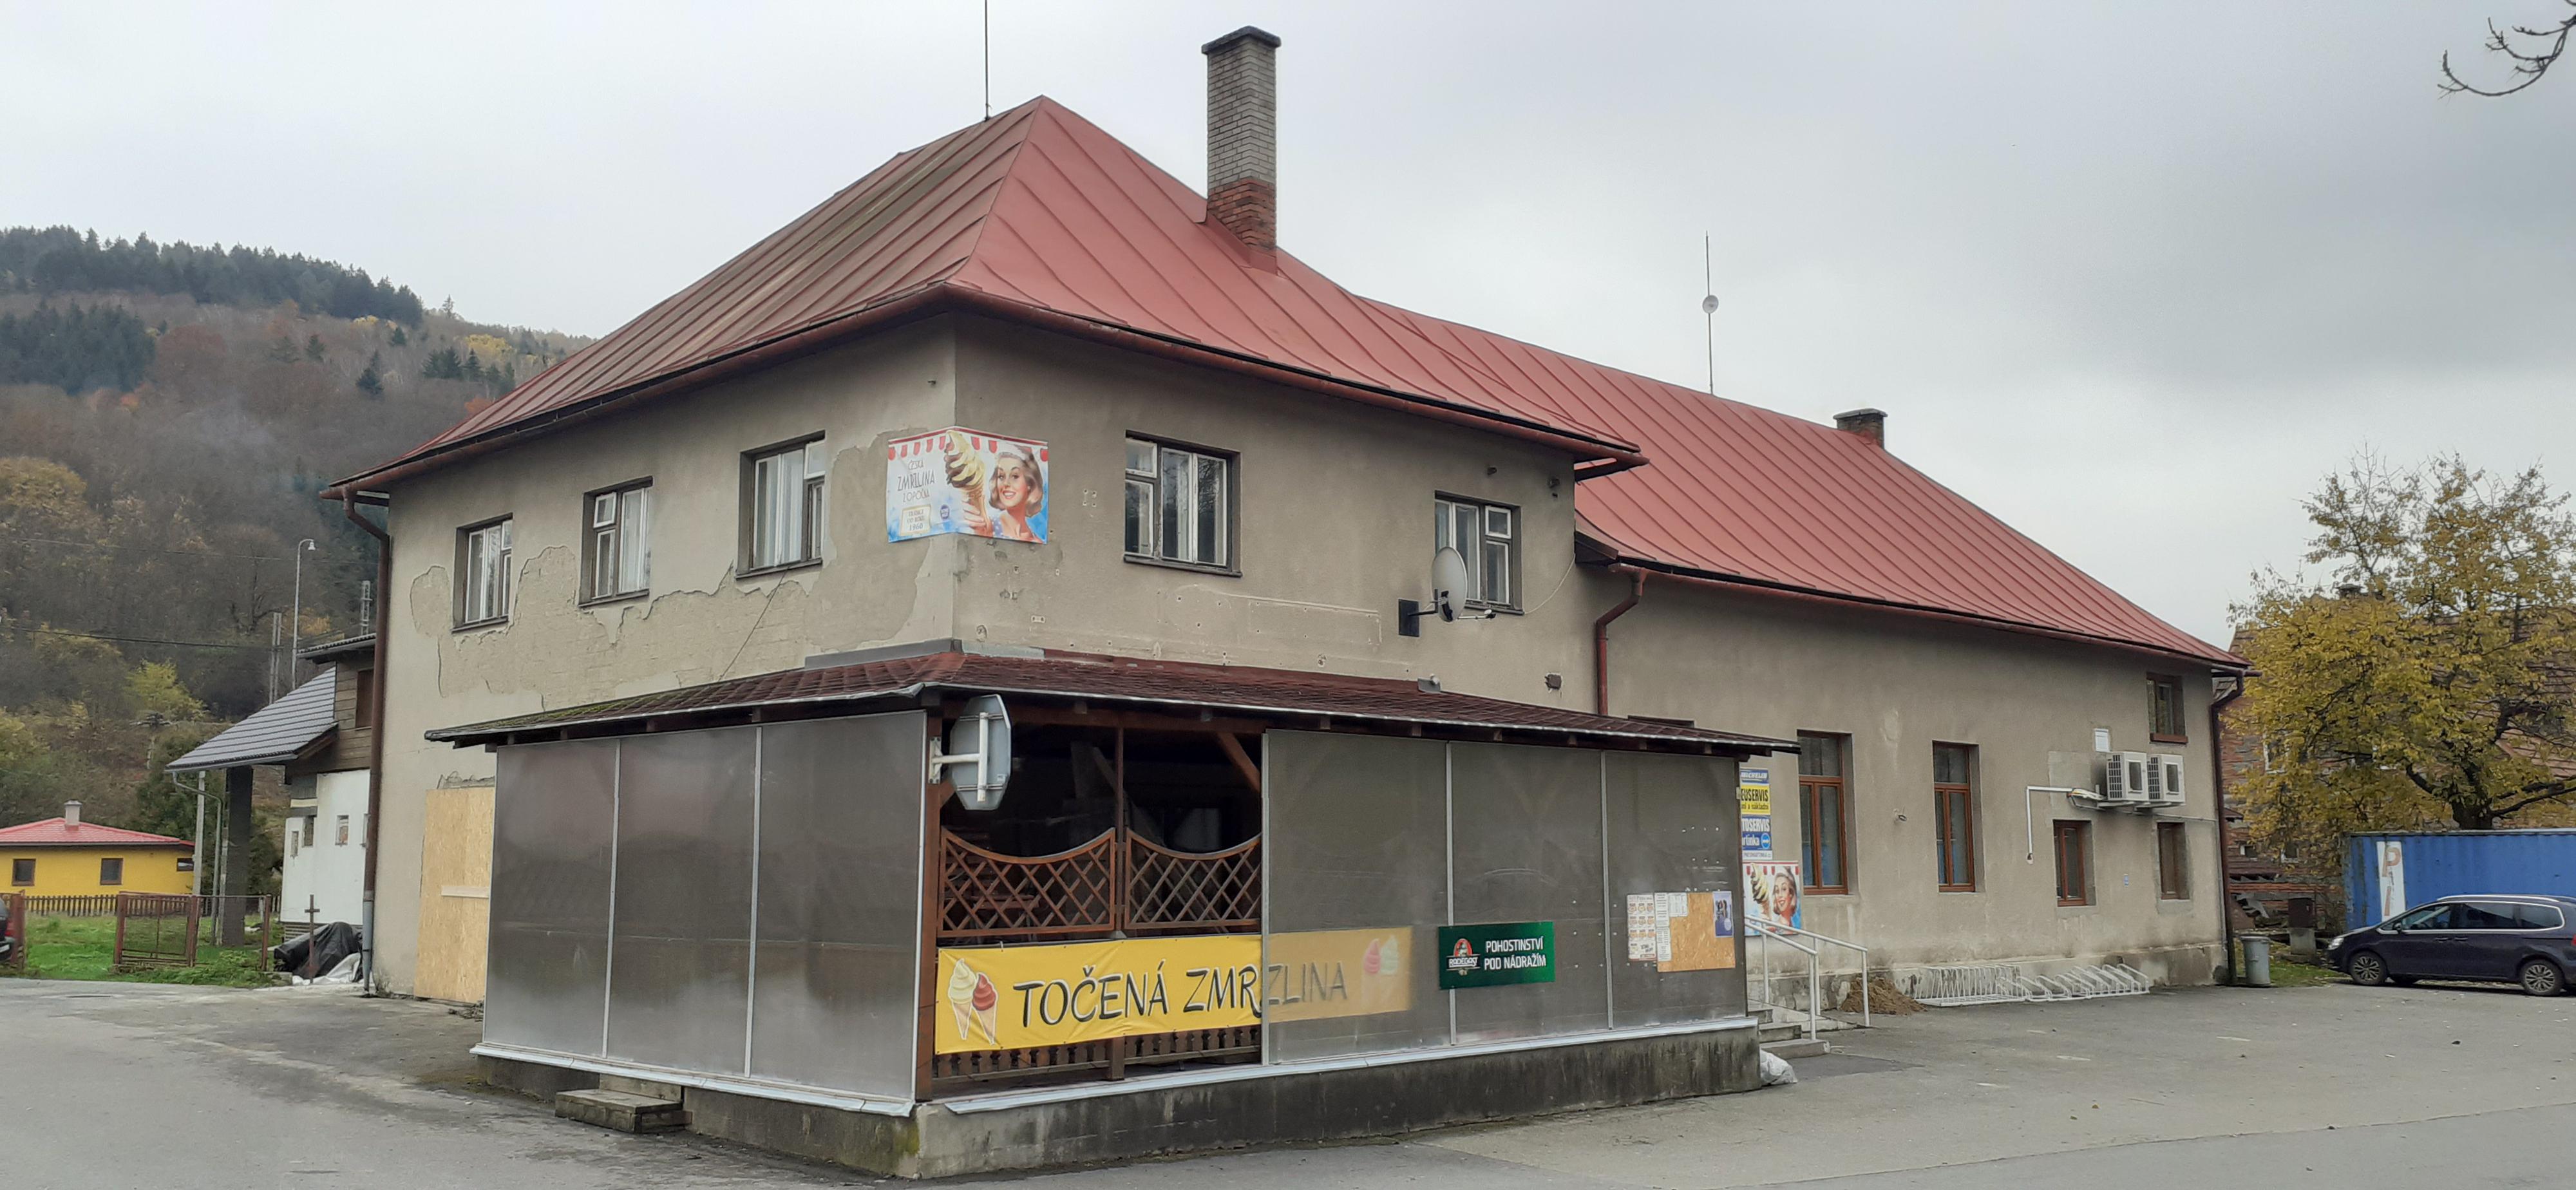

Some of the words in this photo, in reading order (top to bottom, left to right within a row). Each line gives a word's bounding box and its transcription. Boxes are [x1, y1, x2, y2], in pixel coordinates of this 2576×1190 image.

[897, 469, 935, 491] ZMRZLINA
[1485, 936, 1544, 953] POHOSTINSTVÍ
[1484, 957, 1501, 970] POD
[1503, 952, 1547, 969] NÁDRAŽÍM
[1013, 959, 1170, 1028] TOČENÁ
[1183, 960, 1348, 1019] ZMRZLINA
